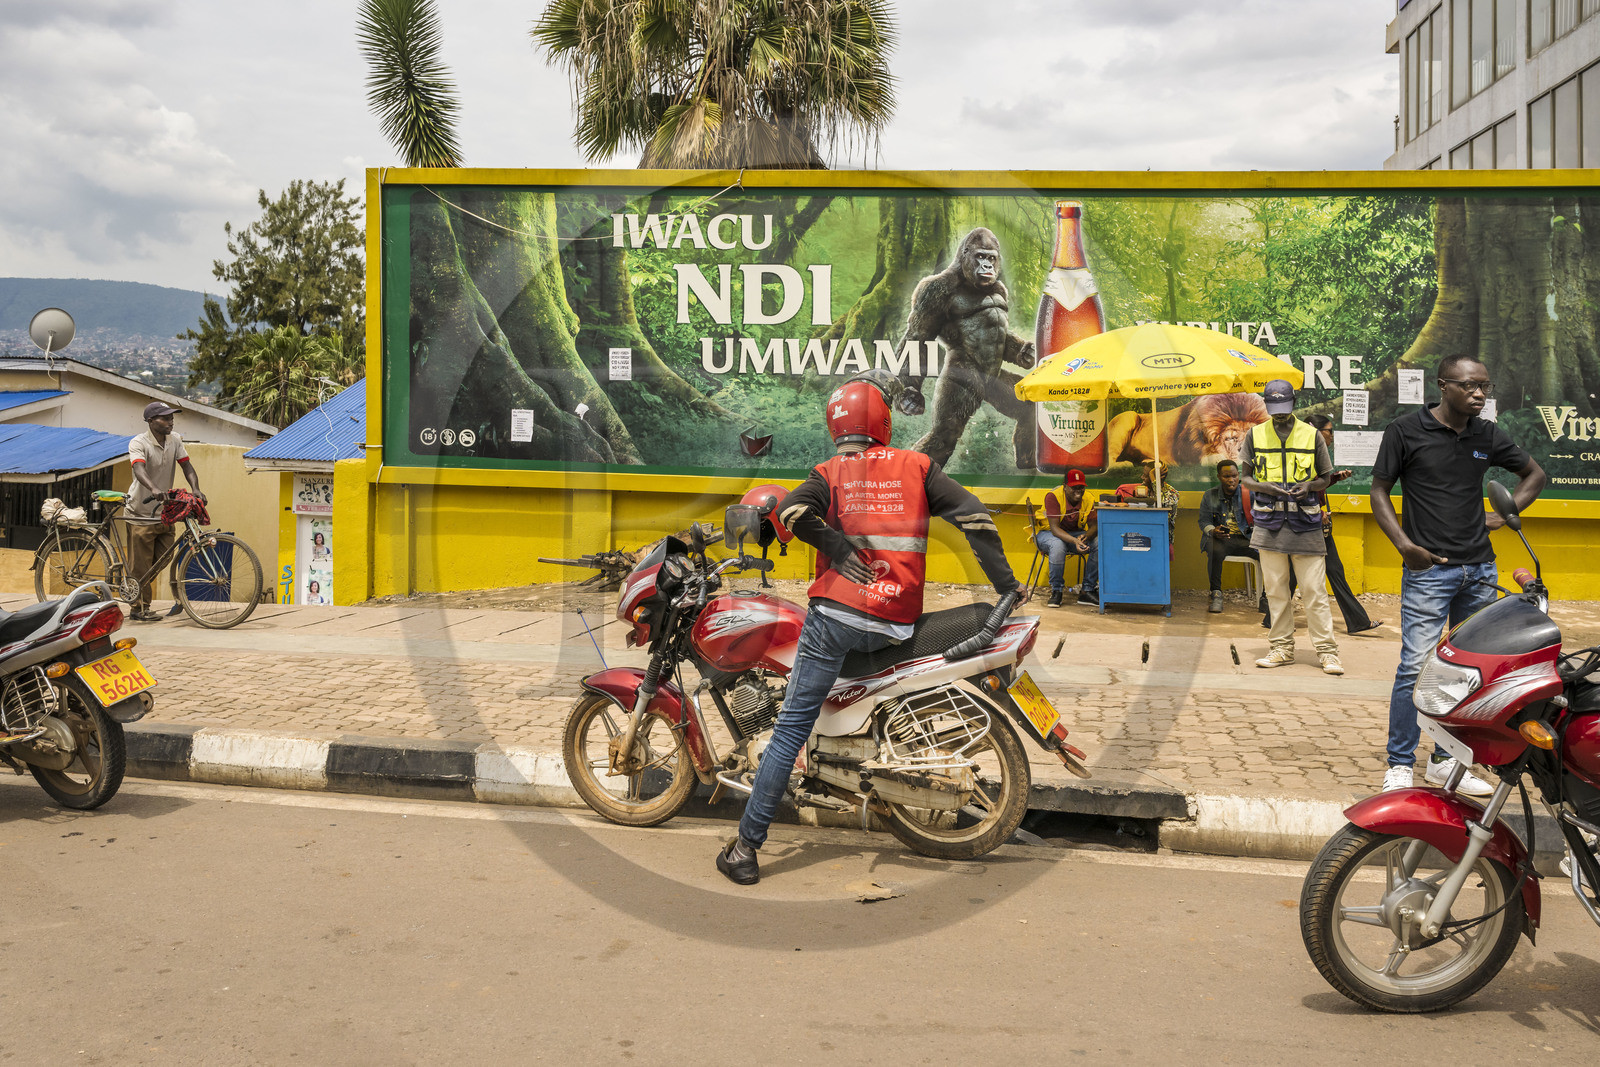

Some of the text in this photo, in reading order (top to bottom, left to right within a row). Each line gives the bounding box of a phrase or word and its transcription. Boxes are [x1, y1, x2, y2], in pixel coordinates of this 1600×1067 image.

[611, 213, 773, 250] IWACU
[673, 263, 832, 326] NDI
[699, 337, 939, 377] UMWAMI
[1135, 383, 1182, 392] everywhere
[1200, 381, 1212, 389] go
[1048, 414, 1095, 433] Virunga
[879, 480, 902, 489] HOSE
[877, 492, 903, 500] MONEY
[858, 588, 892, 605] money
[860, 581, 901, 597] rtel
[1440, 646, 1455, 657] TVS
[92, 658, 121, 680] RG
[100, 670, 149, 700] 562H
[1015, 680, 1035, 705] RG
[831, 687, 865, 702] Victor
